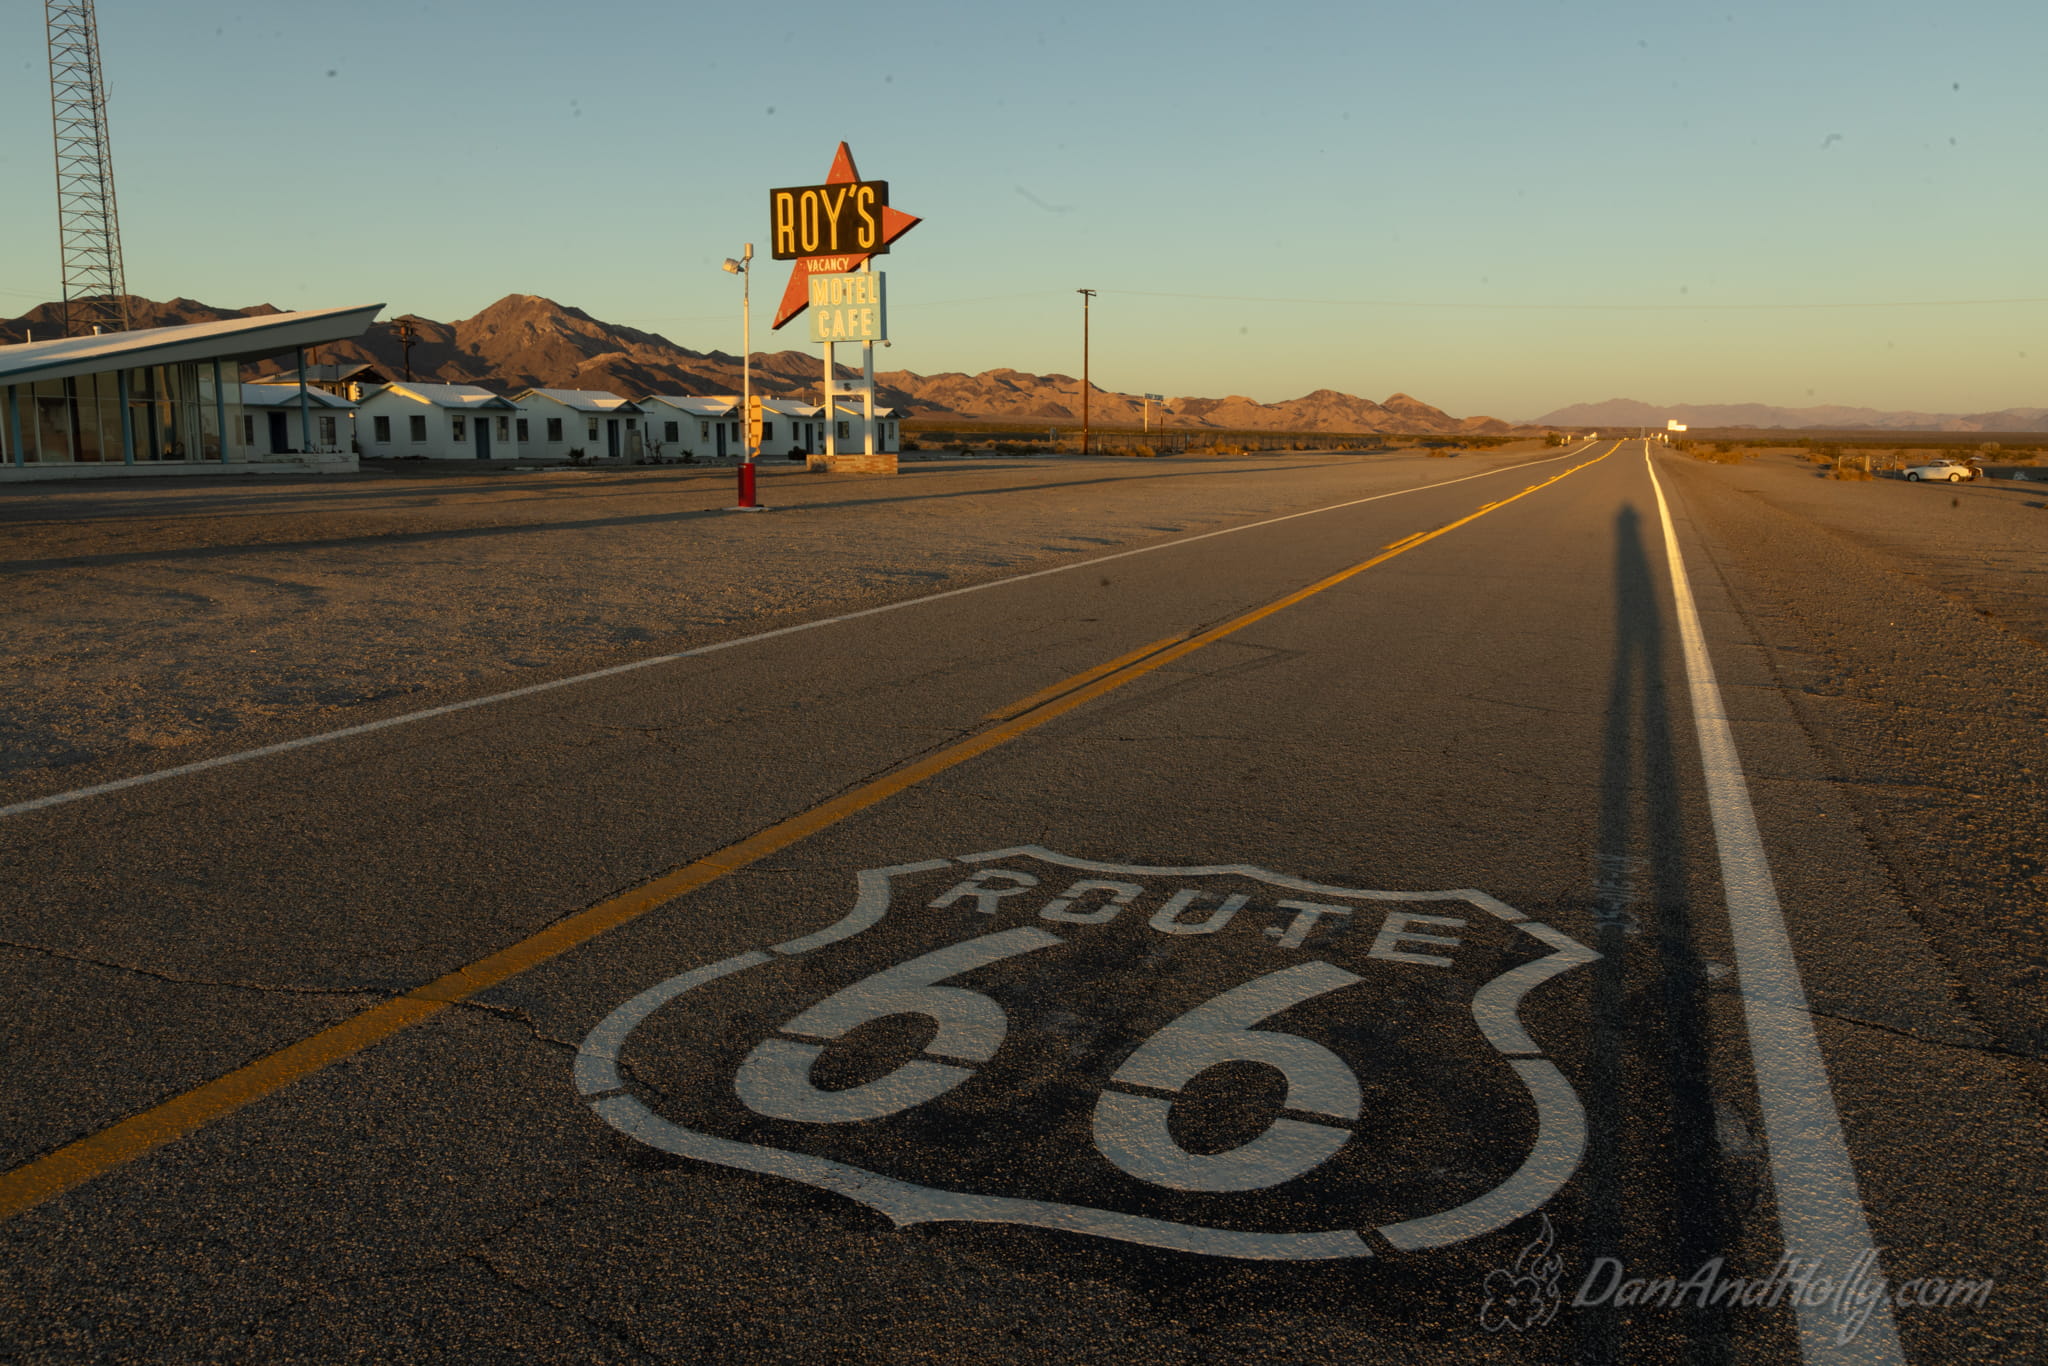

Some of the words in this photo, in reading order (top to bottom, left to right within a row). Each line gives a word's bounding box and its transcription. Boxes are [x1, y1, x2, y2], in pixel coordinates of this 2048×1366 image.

[776, 184, 876, 253] ROY'S
[806, 257, 849, 272] VACANCY
[812, 275, 877, 306] MOTEL
[818, 308, 872, 337] CAFE
[930, 868, 1467, 967] ROUTE
[735, 926, 1361, 1193] 66
